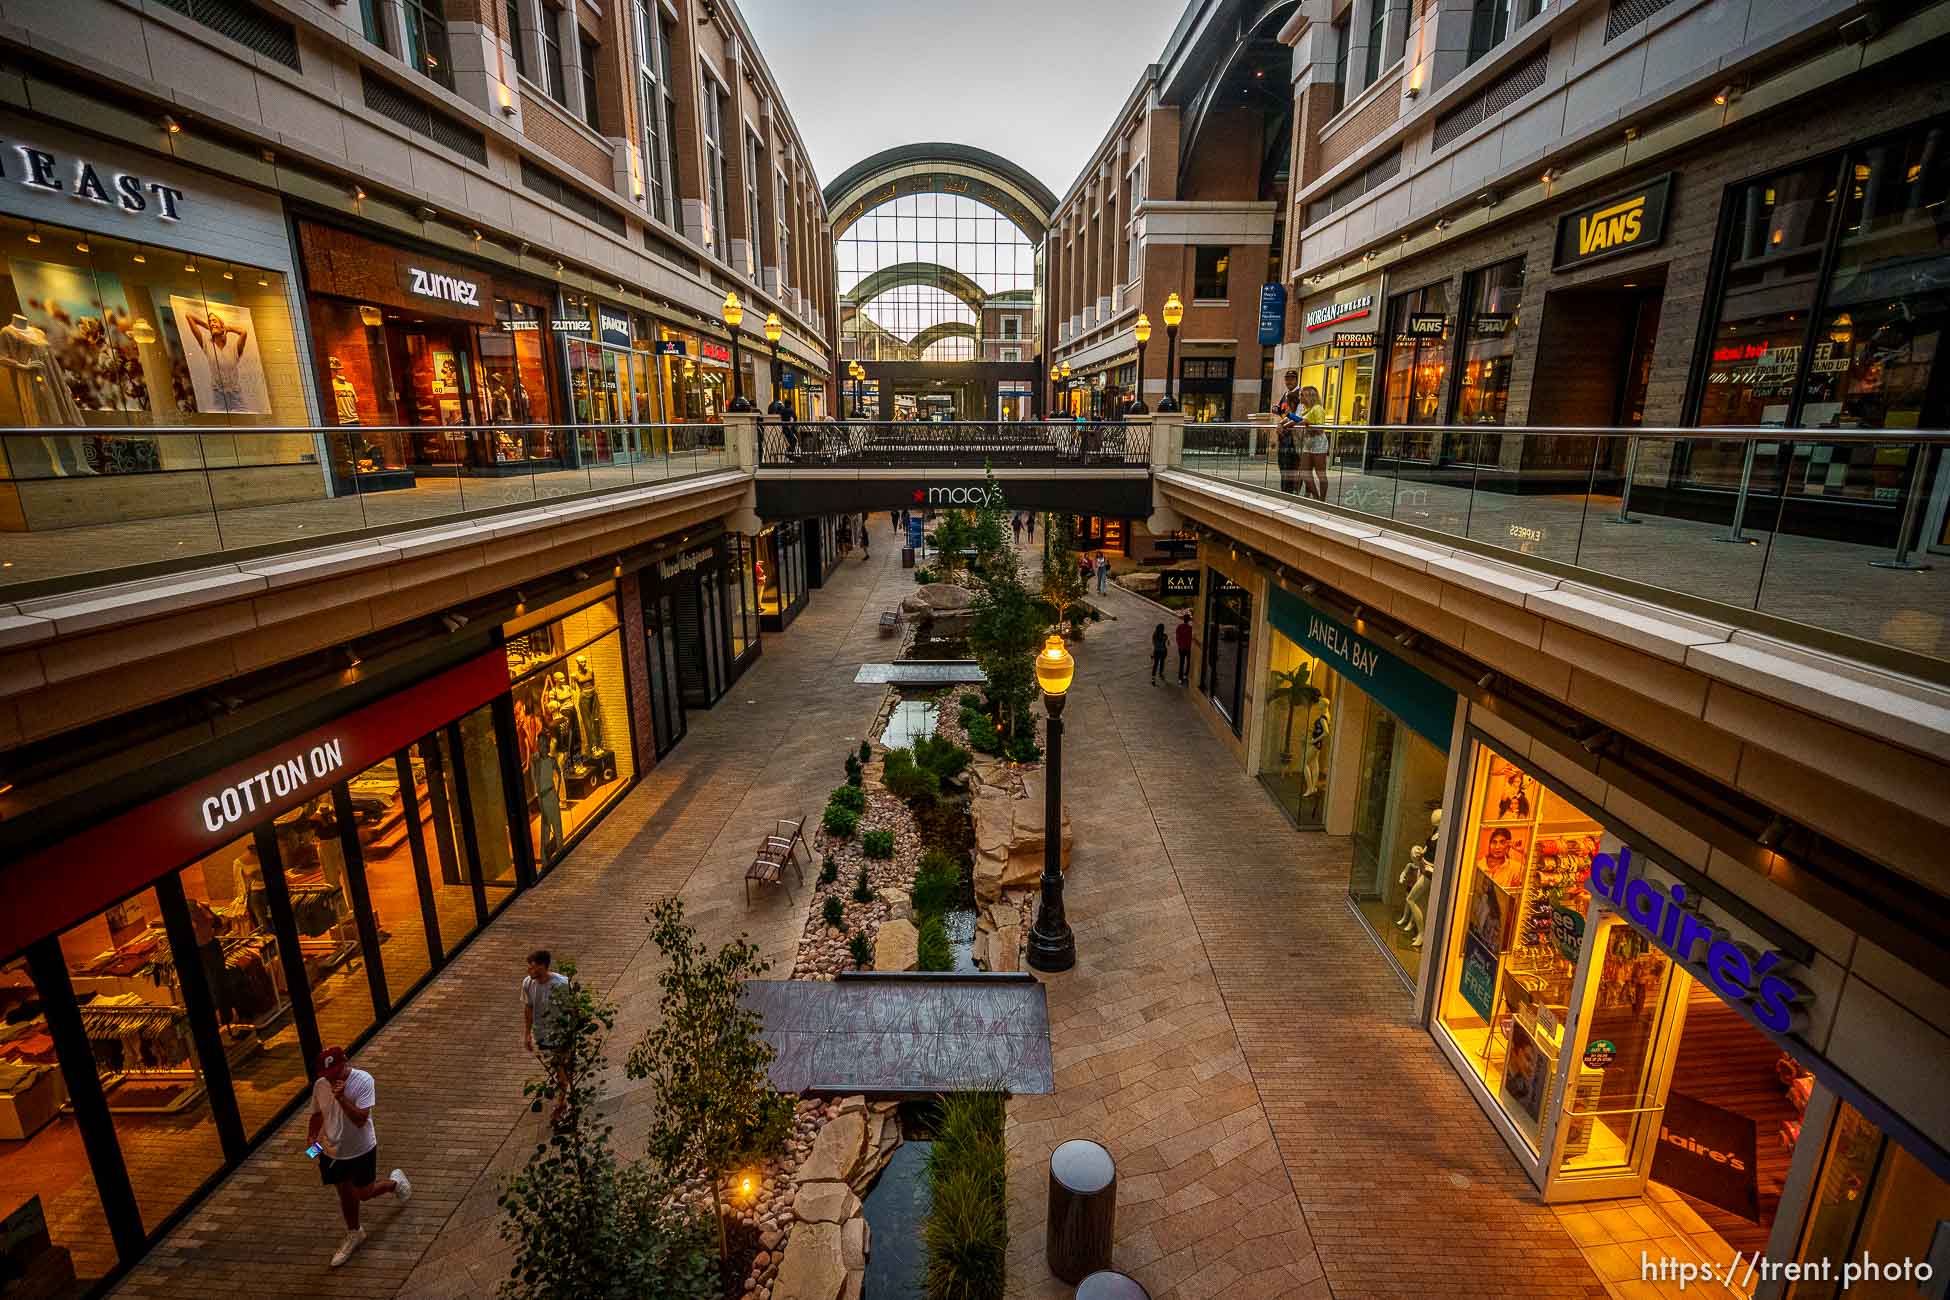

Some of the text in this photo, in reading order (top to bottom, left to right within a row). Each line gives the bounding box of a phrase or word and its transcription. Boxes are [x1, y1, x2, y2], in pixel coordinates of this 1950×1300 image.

[0, 142, 183, 222] EAST
[1580, 195, 1646, 256] VANS
[551, 320, 591, 331] zumiez
[1305, 295, 1371, 328] MORGAN JEWELERS
[1412, 319, 1442, 332] VANS
[1336, 333, 1373, 342] MORGAN
[1167, 577, 1194, 586] KAY
[1307, 615, 1378, 677] JANELA BAY
[202, 738, 343, 832] COTTON ON
[1591, 846, 1796, 1033] claire's
[324, 1055, 334, 1068] P
[1658, 1125, 1746, 1172] laire's
